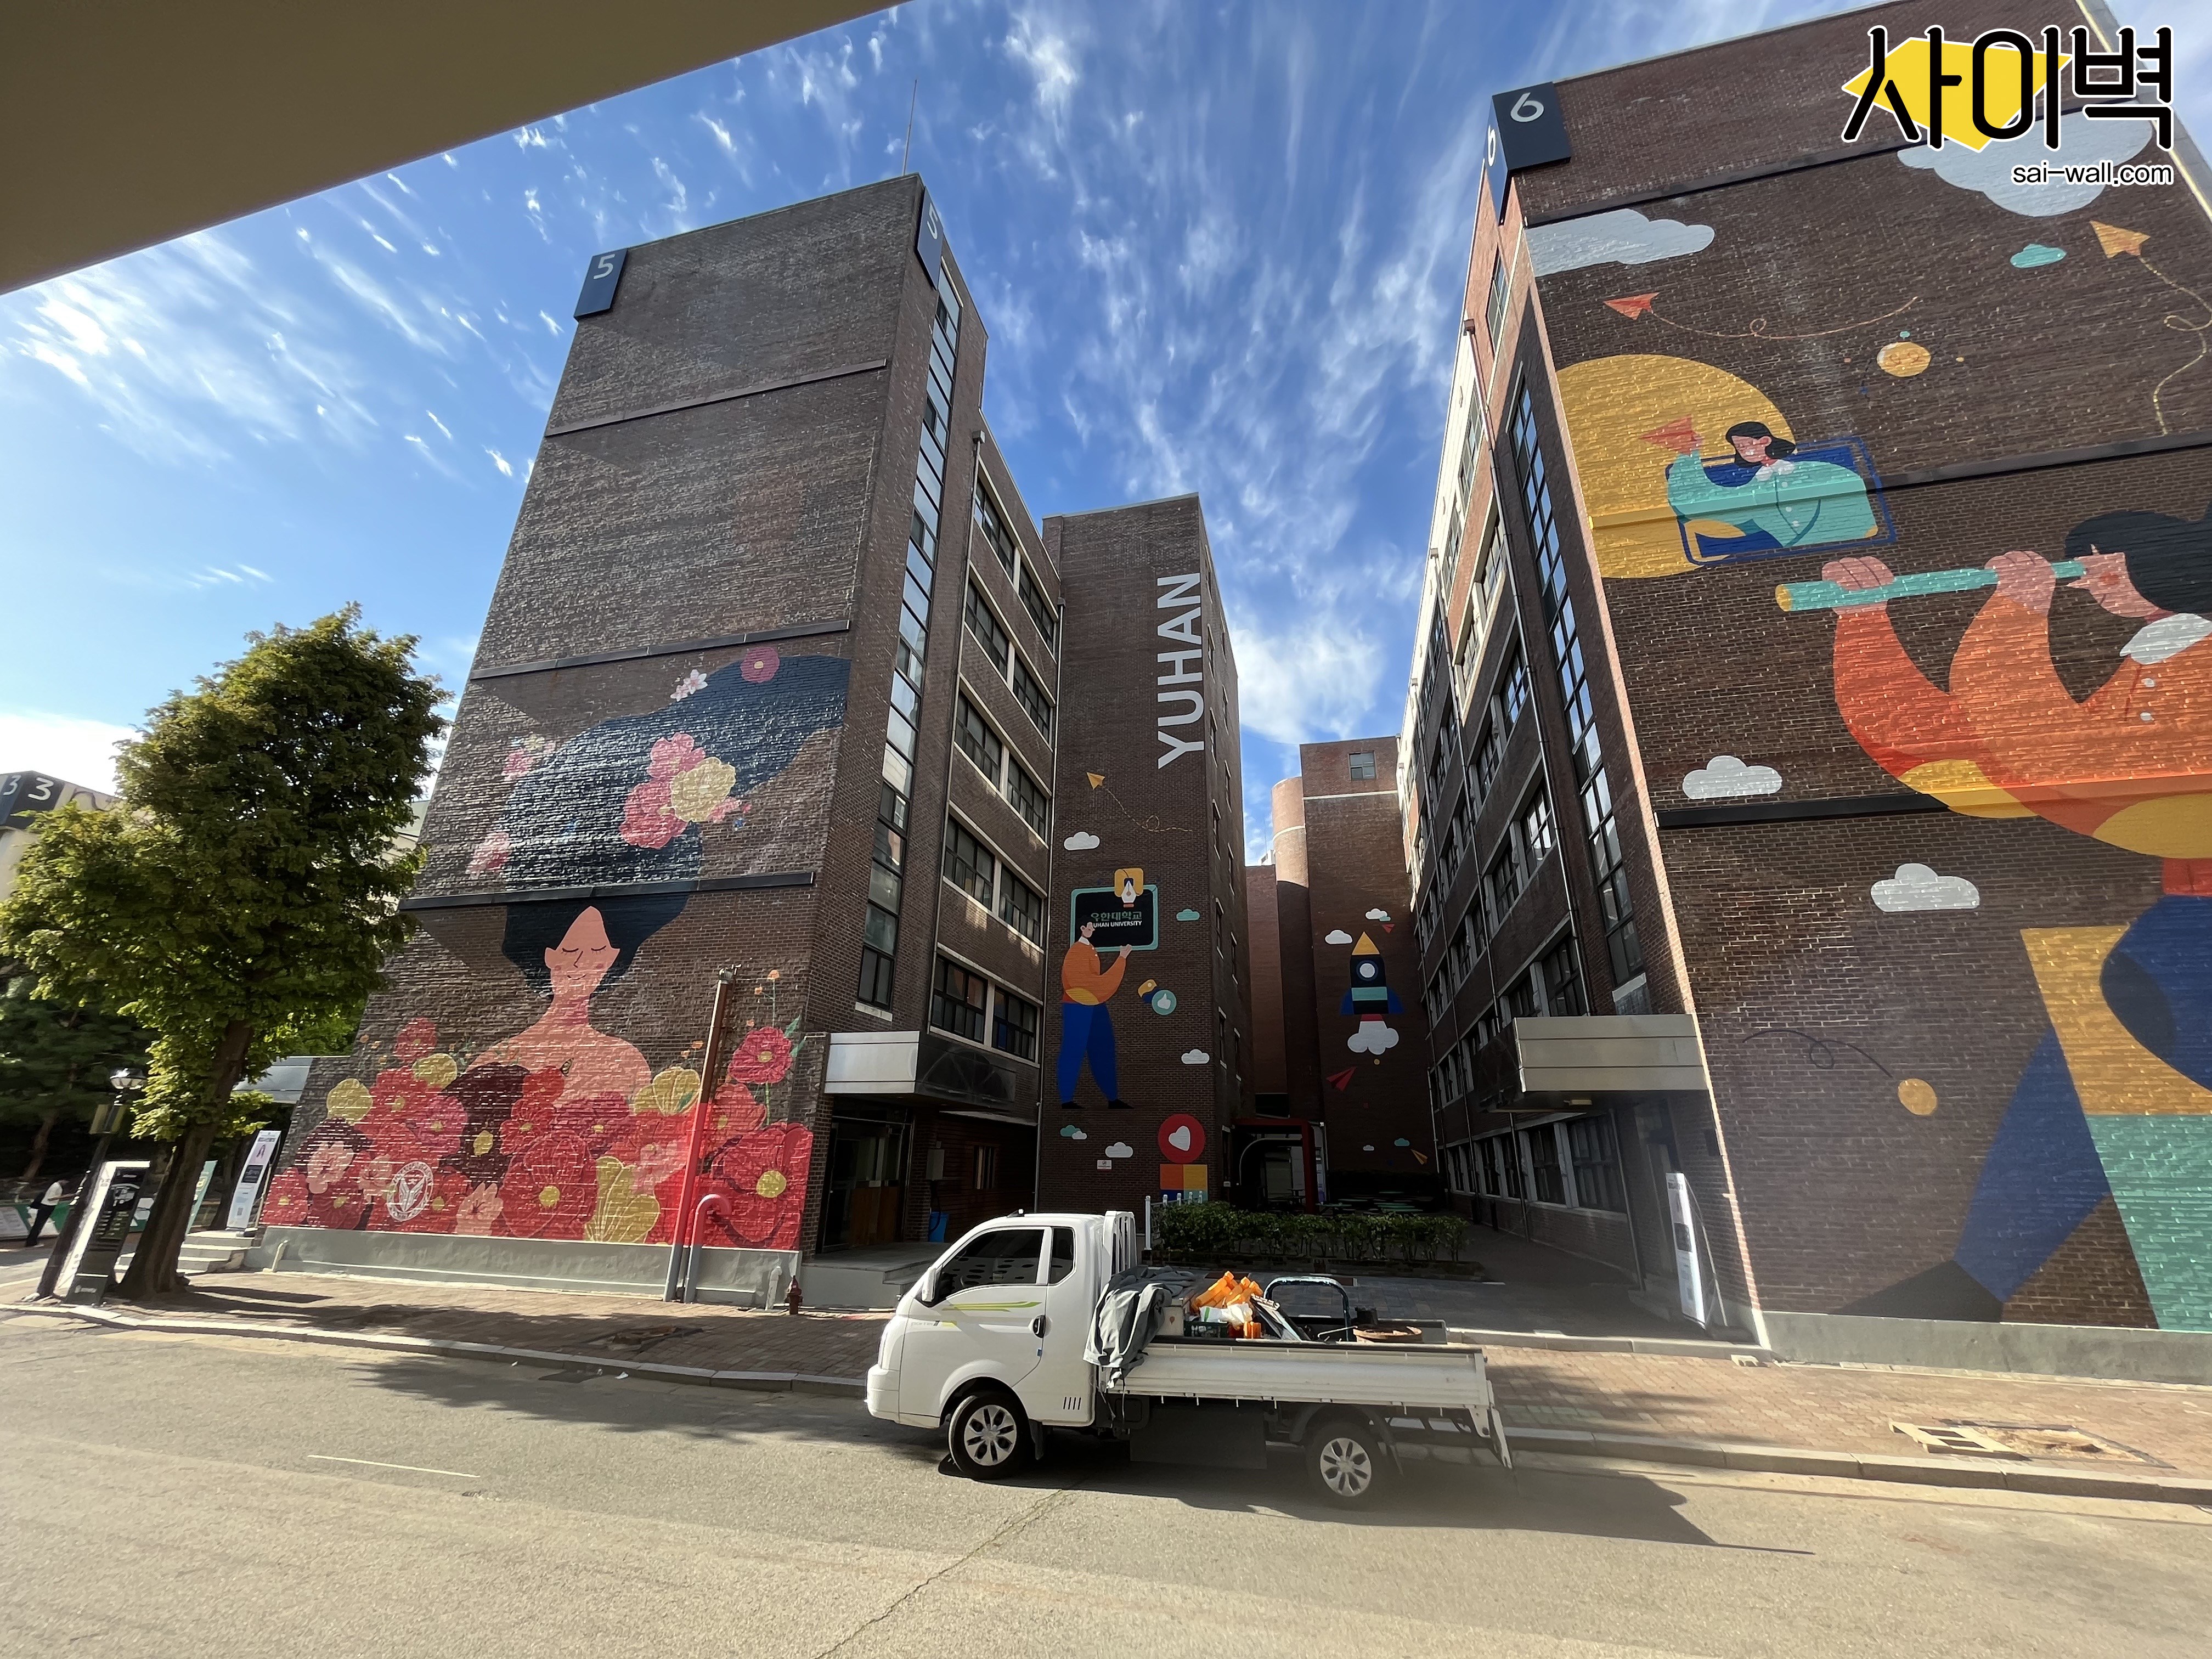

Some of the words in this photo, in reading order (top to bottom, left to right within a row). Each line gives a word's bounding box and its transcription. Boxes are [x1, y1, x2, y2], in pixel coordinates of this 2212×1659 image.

[1510, 92, 1544, 122] 6
[927, 202, 938, 239] 5
[593, 253, 615, 279] 5
[1157, 572, 1204, 769] YUHAN
[3, 775, 21, 795] 3
[28, 777, 54, 800] 3
